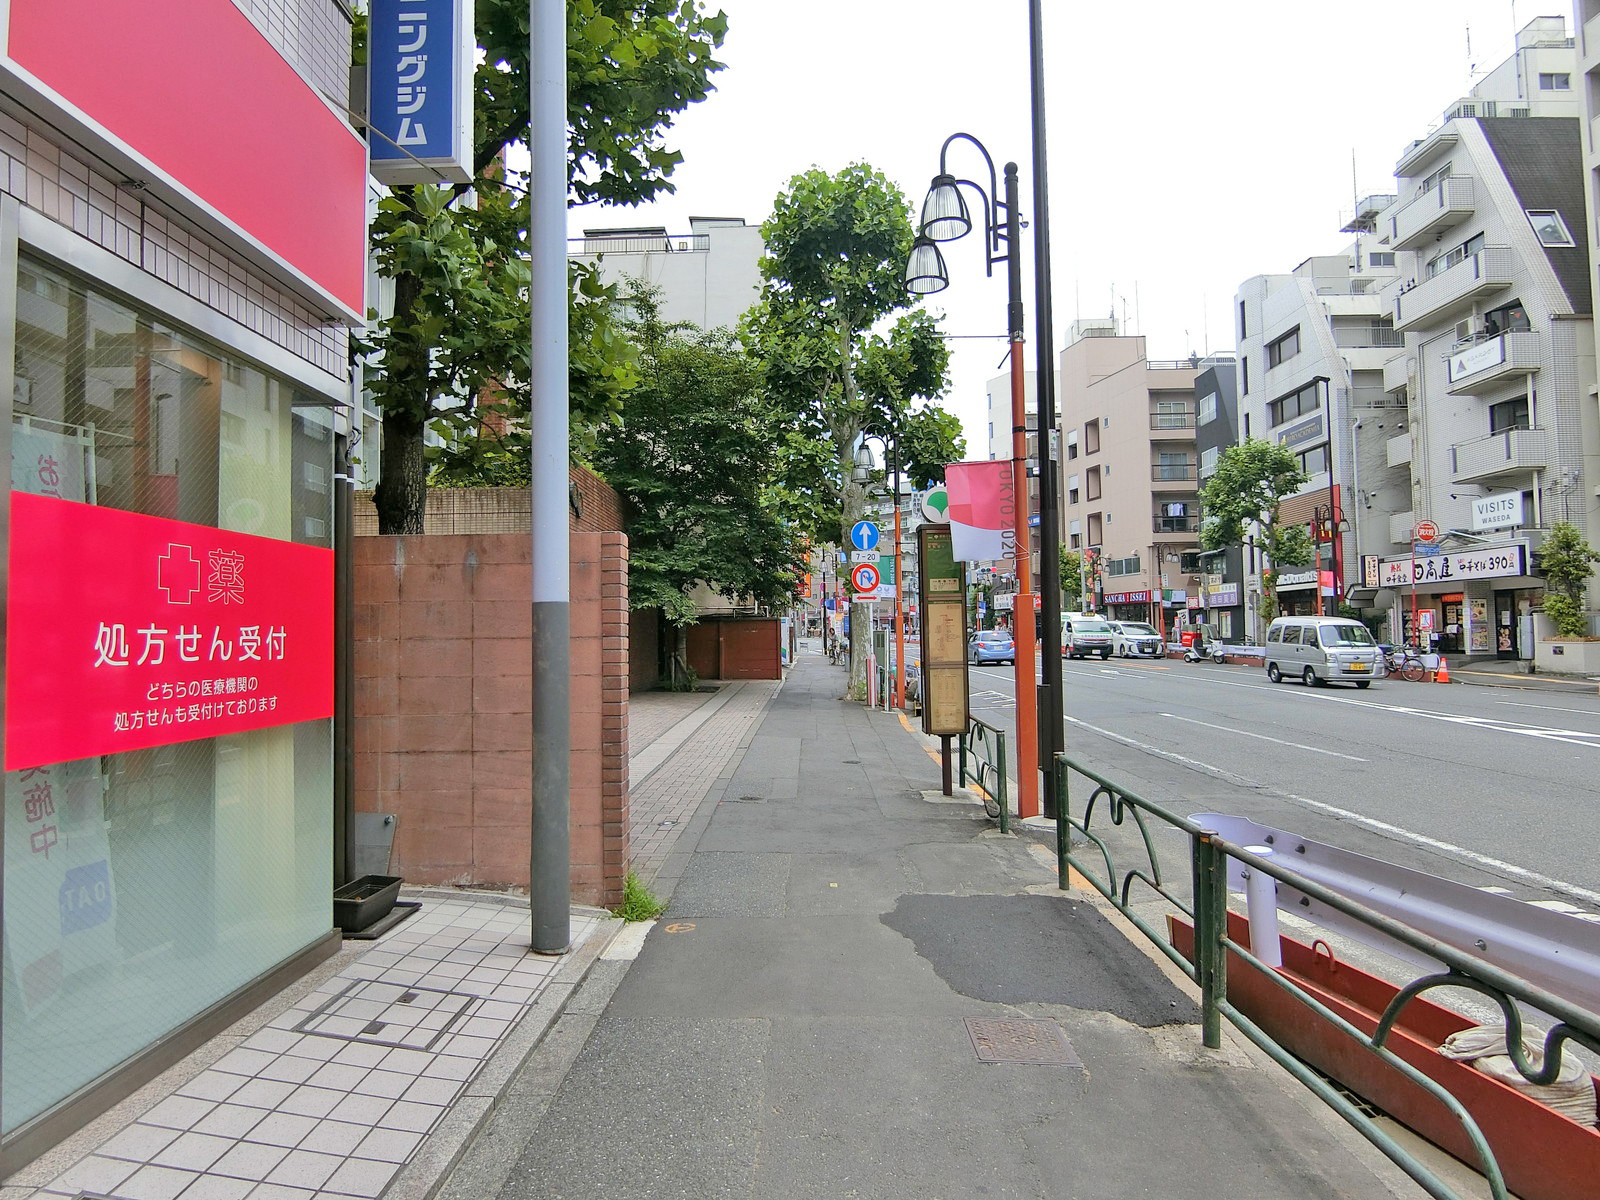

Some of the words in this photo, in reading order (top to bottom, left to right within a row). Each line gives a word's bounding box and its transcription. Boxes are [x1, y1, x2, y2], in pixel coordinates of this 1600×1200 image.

[1478, 498, 1515, 515] VISITS
[1482, 514, 1511, 524] WASEDA
[1000, 519, 1017, 560] 2020
[208, 548, 245, 605] 薬
[1414, 557, 1453, 580] 日高屋
[1104, 594, 1126, 603] SANCHA
[1129, 592, 1147, 602] ISSEI
[94, 621, 287, 668] 処方せん受付
[146, 676, 258, 701] どちらの医療機関の
[114, 695, 278, 733] 処方せんも受付けております
